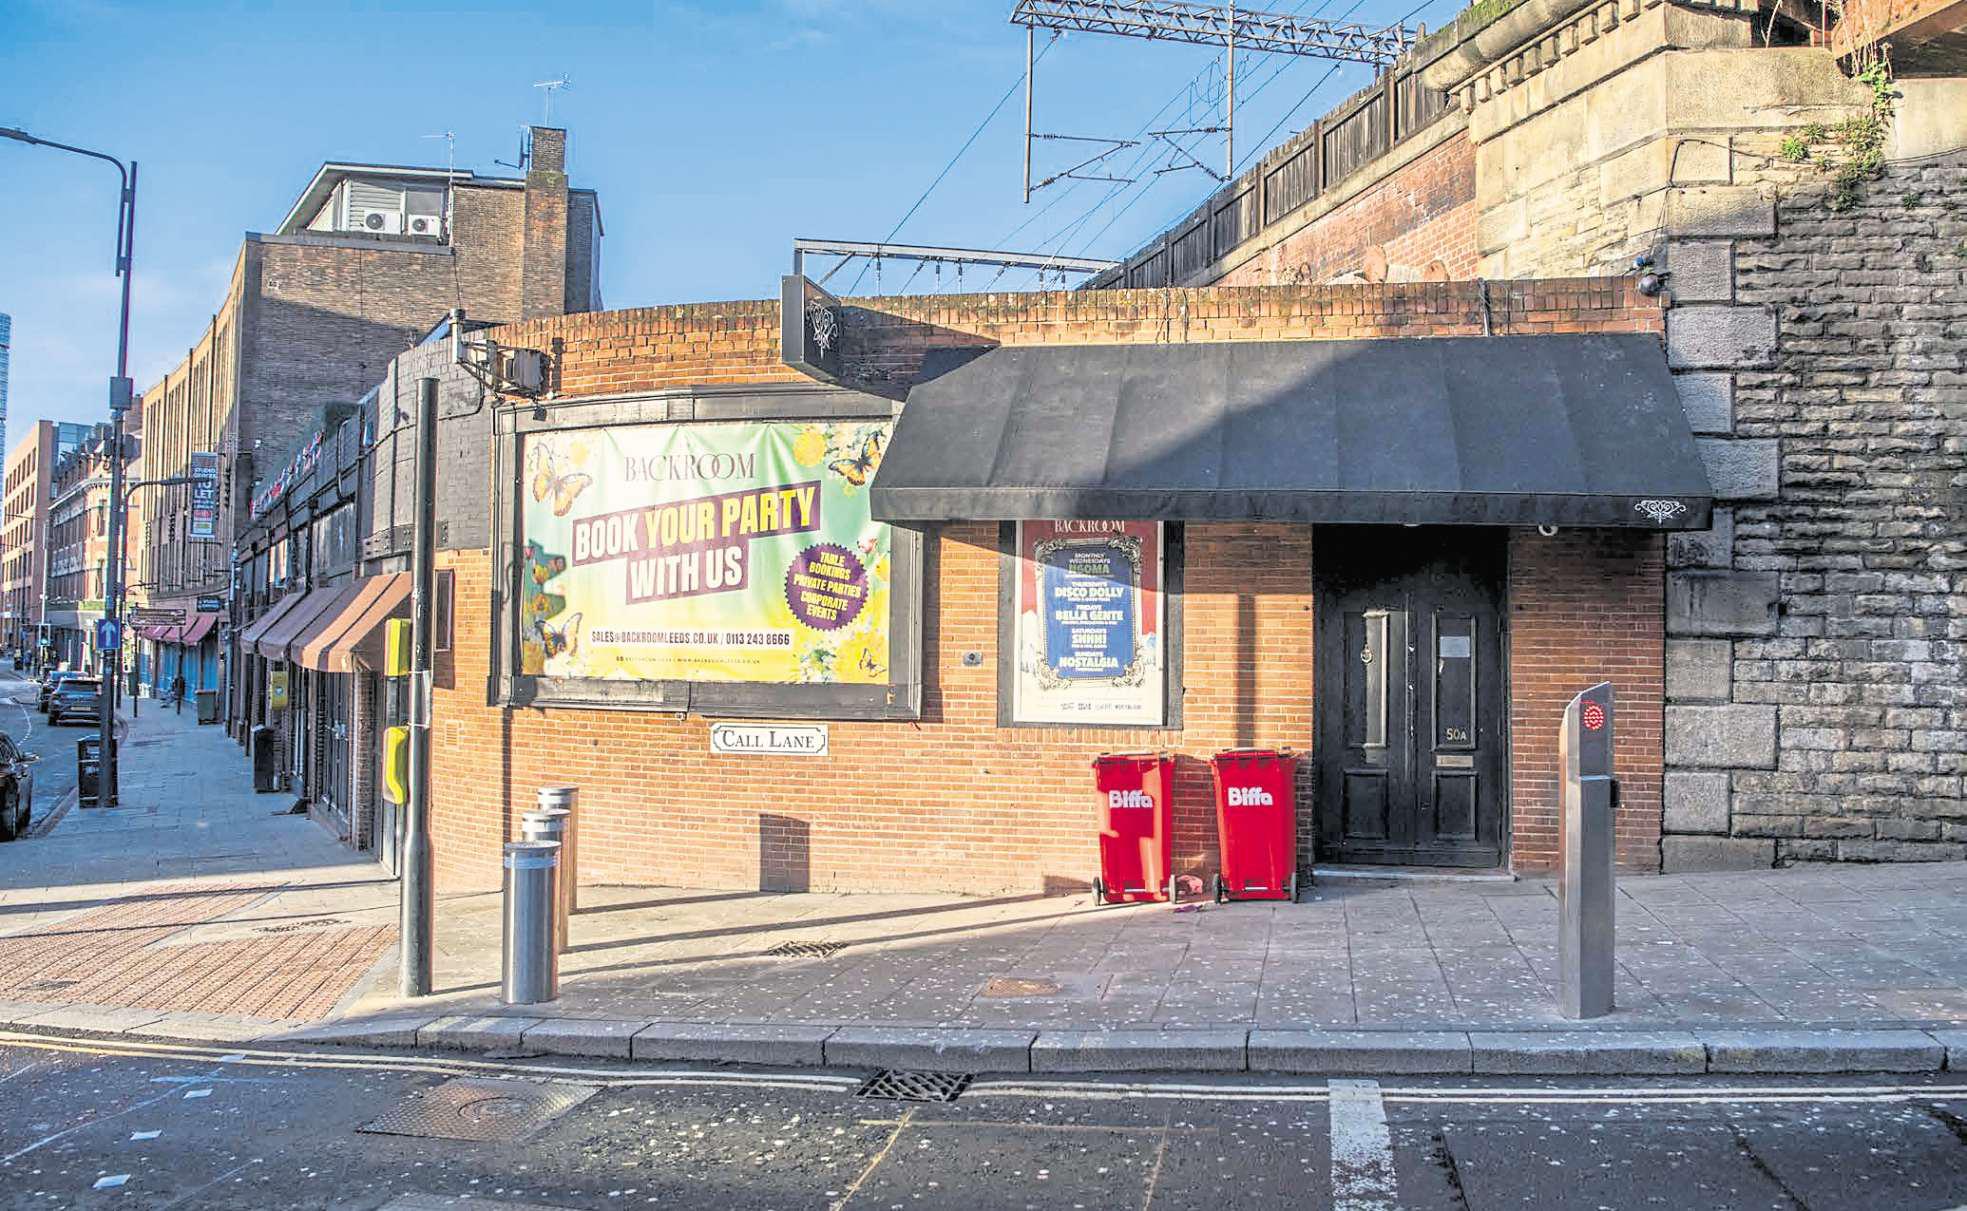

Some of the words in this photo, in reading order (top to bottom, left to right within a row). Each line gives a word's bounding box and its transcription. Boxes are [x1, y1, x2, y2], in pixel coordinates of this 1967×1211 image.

[625, 453, 756, 482] BACKROOM
[195, 488, 214, 499] LET
[576, 511, 639, 561] BOOK
[644, 501, 715, 549] YOUR
[721, 486, 816, 538] PARTY
[1054, 519, 1125, 533] BACKROOM
[820, 551, 846, 567] TABLE
[630, 552, 700, 599] WITH
[705, 545, 743, 590] US
[809, 561, 851, 580] BOOKINGS
[793, 573, 828, 590] PRIVATE
[826, 580, 862, 598] PARTIES
[1055, 587, 1087, 597] DISCO
[1089, 587, 1124, 597] DOLLY
[800, 591, 849, 611] CORPORATE
[806, 604, 838, 621] EVENTS
[1055, 610, 1088, 621] BELLA
[1090, 610, 1124, 621] GENTE
[726, 633, 745, 645] 0113
[746, 633, 764, 645] 243
[766, 633, 790, 646] 8666
[1059, 656, 1119, 668] NOSTALGIA
[1446, 728, 1468, 741] 50A
[1109, 788, 1153, 809] Biffa
[1227, 786, 1274, 807] Biffa
